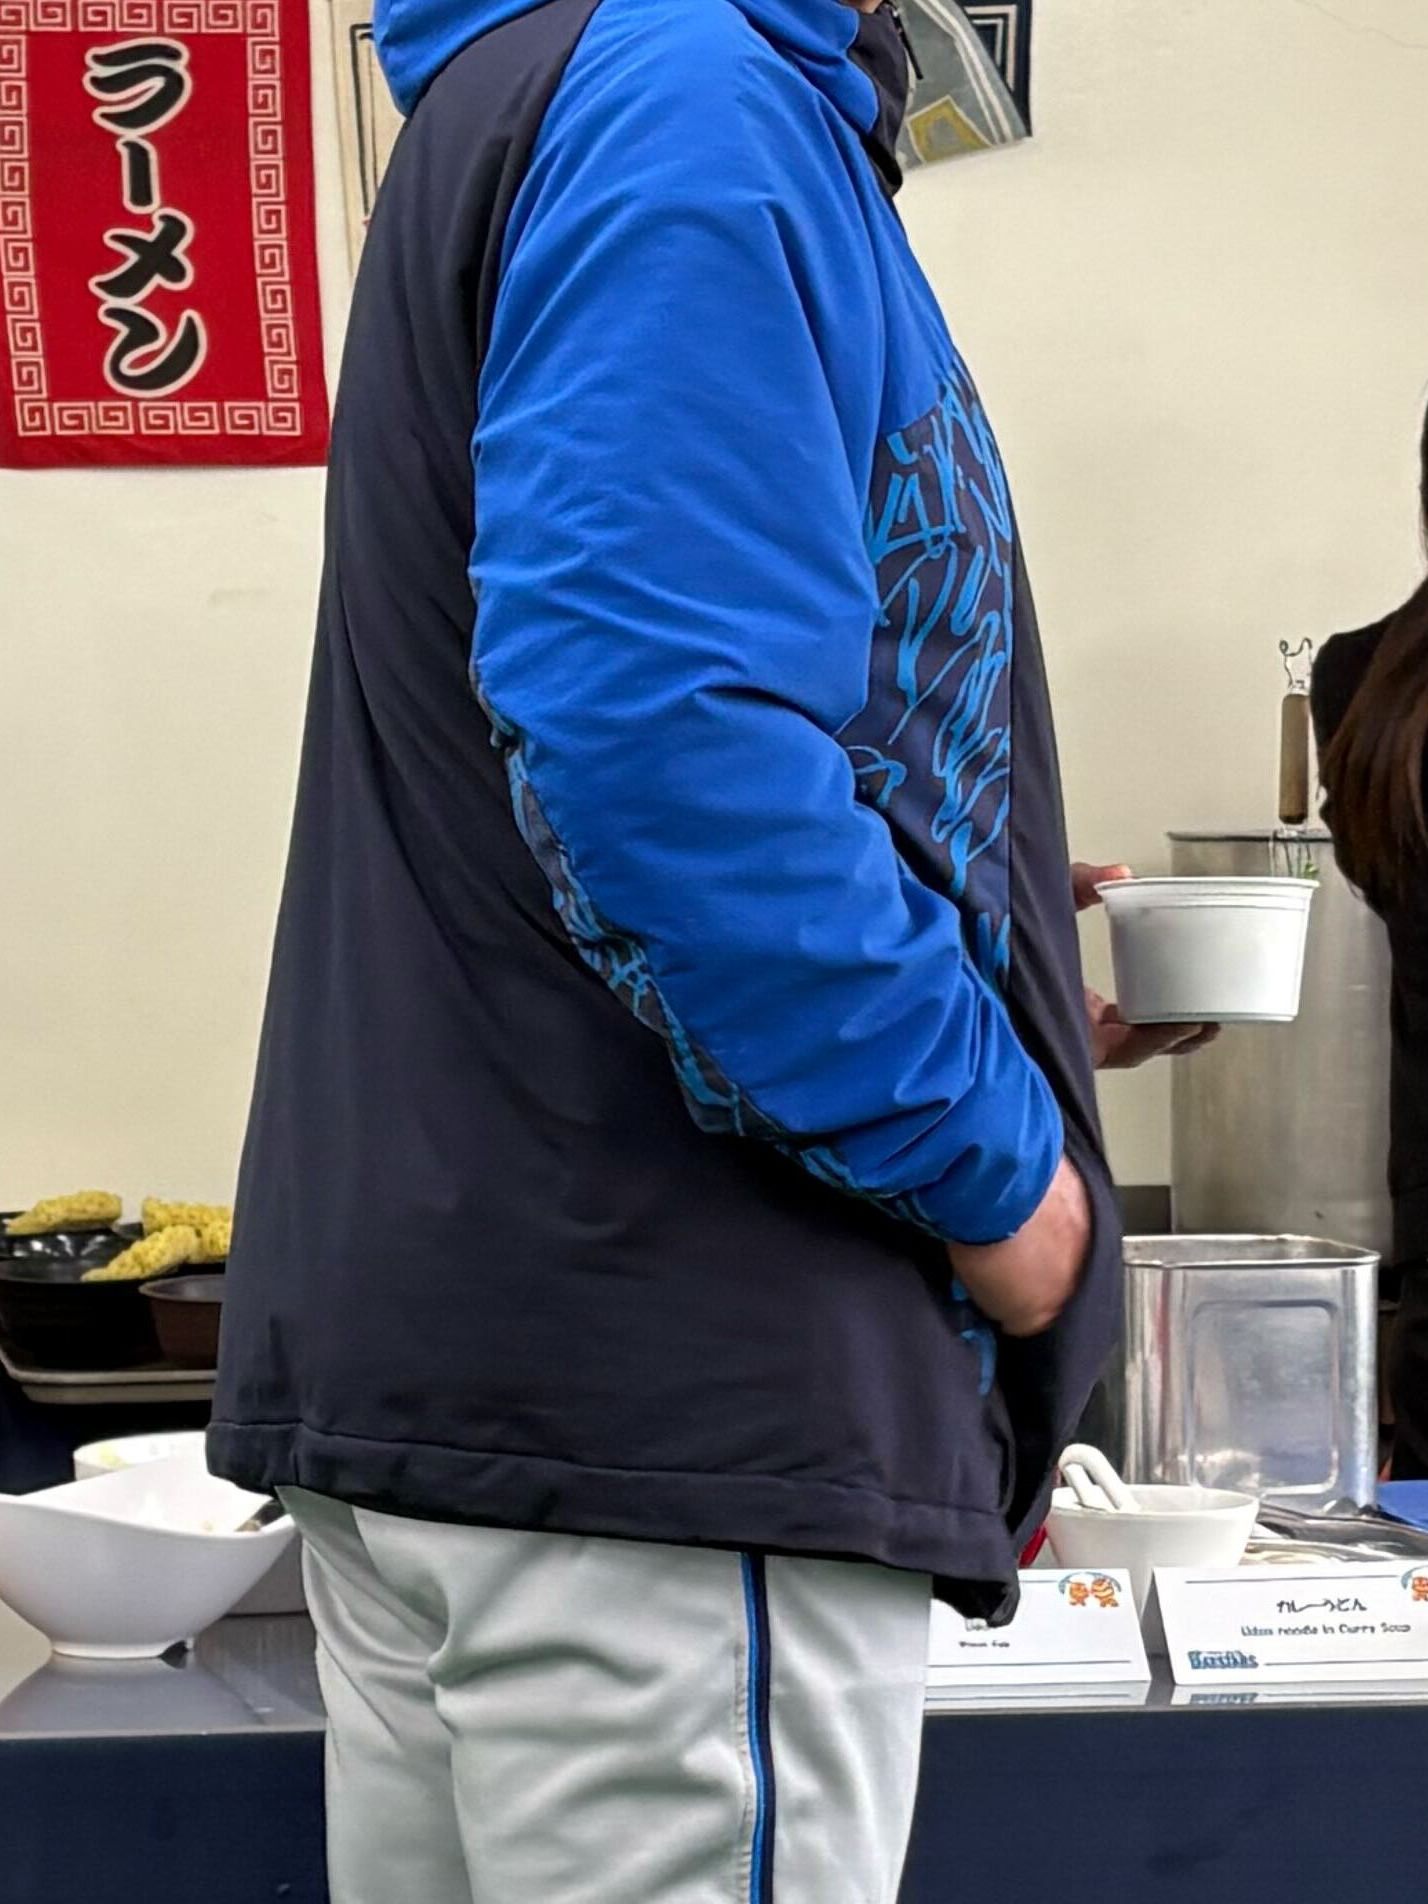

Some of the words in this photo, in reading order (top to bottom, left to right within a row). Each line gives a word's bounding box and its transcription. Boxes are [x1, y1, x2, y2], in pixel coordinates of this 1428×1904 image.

[83, 37, 206, 397] ラーメン
[1276, 1598, 1368, 1614] カレーうどん
